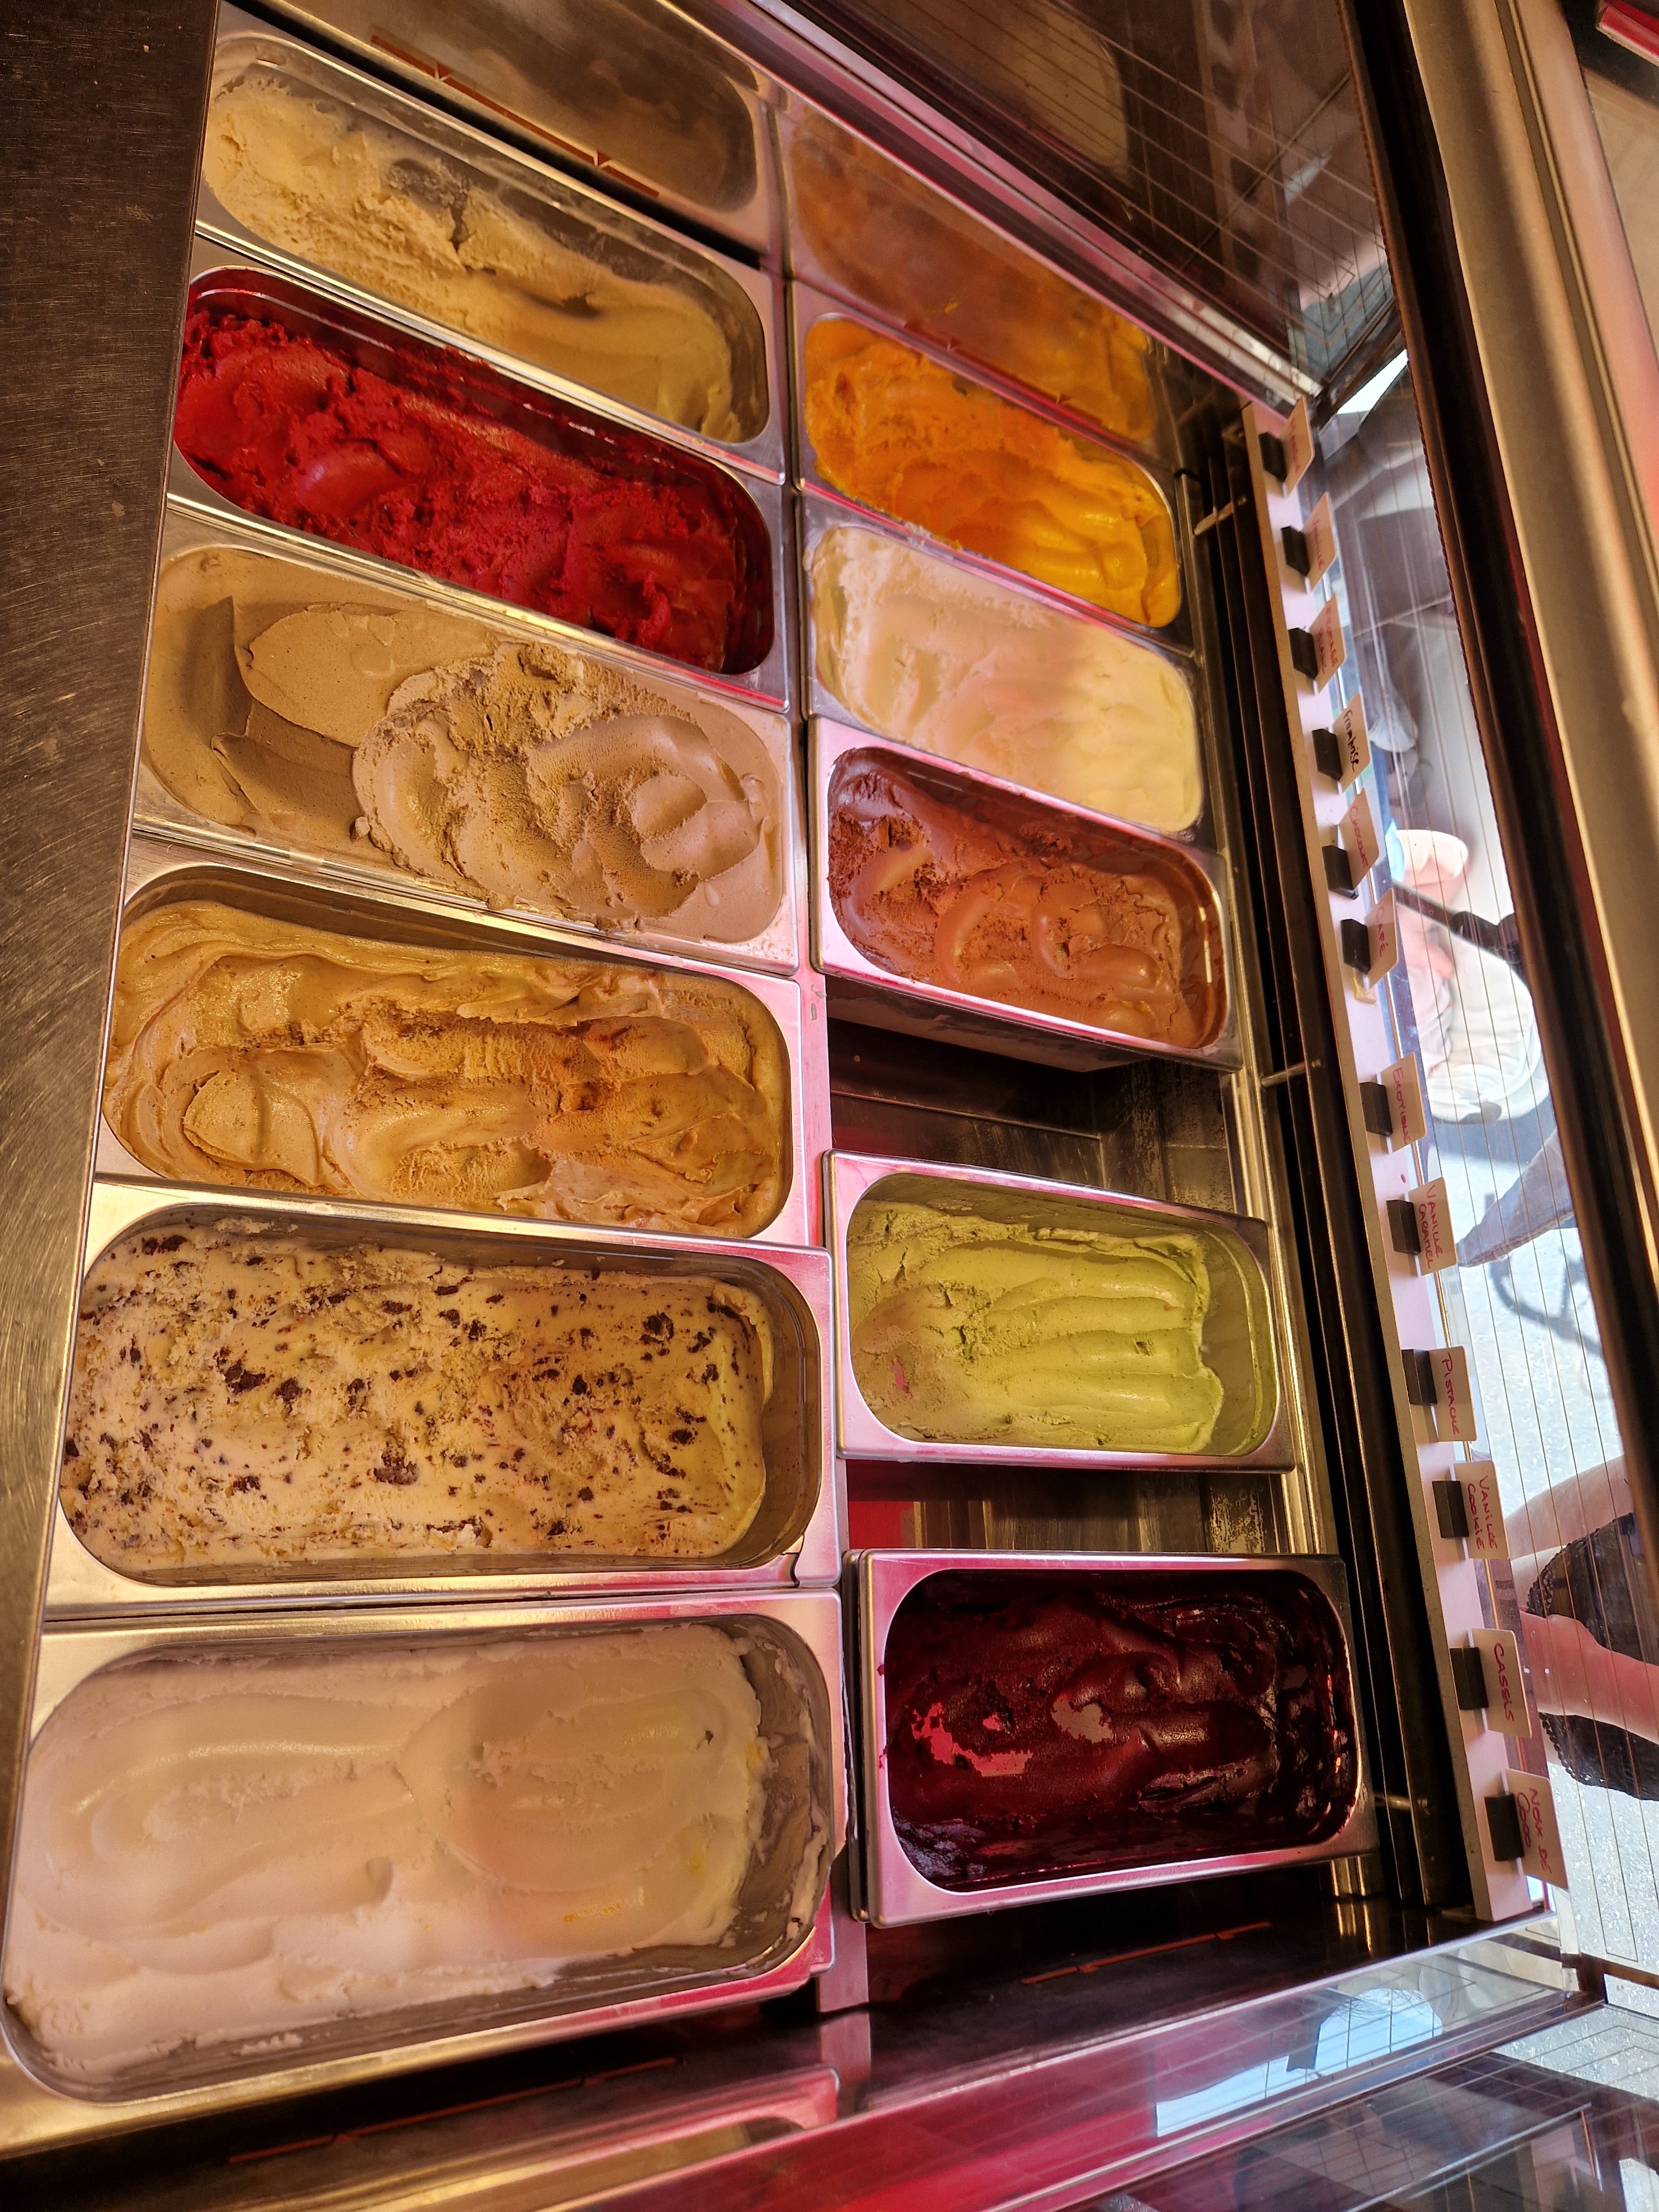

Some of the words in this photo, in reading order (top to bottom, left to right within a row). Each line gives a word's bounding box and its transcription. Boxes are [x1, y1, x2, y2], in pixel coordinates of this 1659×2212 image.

[1376, 906, 1389, 957] CAFÉ
[1418, 1203, 1433, 1269] CARAMEL
[1426, 1185, 1443, 1258] VANILLE
[1442, 1352, 1459, 1435] PISTACHE
[1467, 1483, 1484, 1550] COOKIE
[1494, 1642, 1515, 1722] CASSIS
[1528, 1787, 1543, 1839] NOIX
[1538, 1844, 1552, 1875] DE
